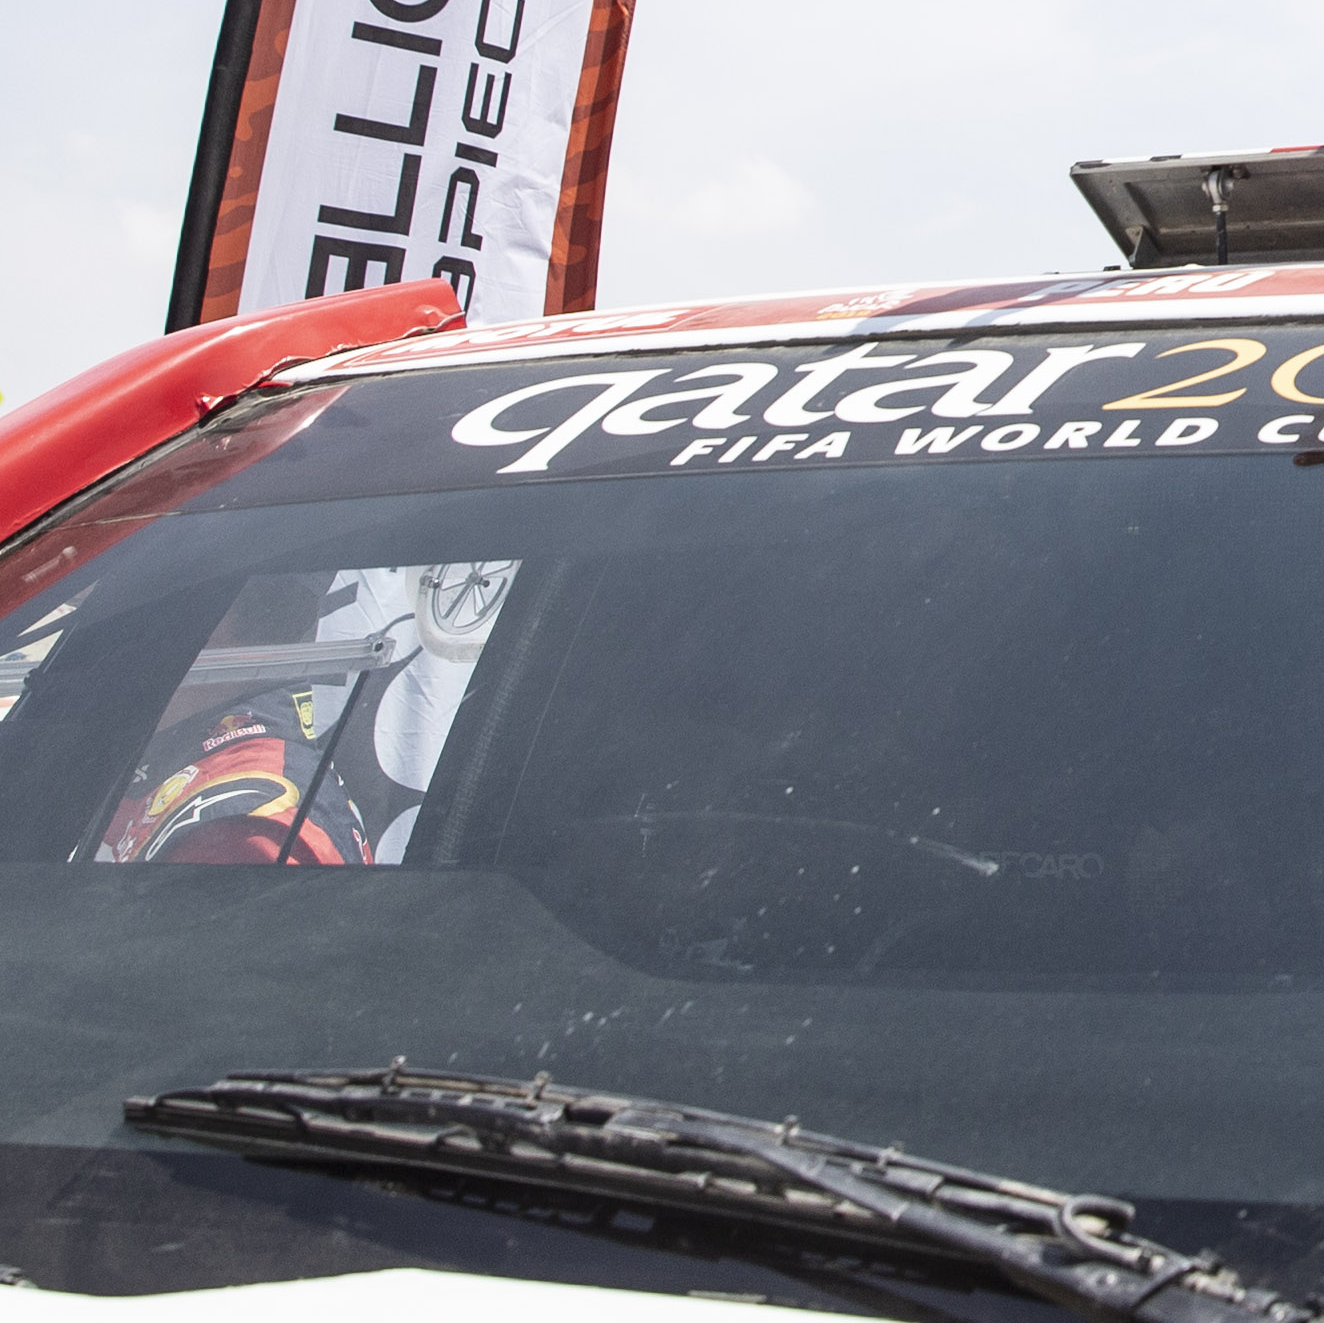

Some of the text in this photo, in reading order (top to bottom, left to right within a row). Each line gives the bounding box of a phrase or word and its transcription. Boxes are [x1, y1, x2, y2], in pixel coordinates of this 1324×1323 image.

[1017, 270, 1277, 301] PERU
[451, 341, 1146, 475] qatar
[670, 431, 852, 467] FIFA
[894, 416, 1221, 457] WORLD
